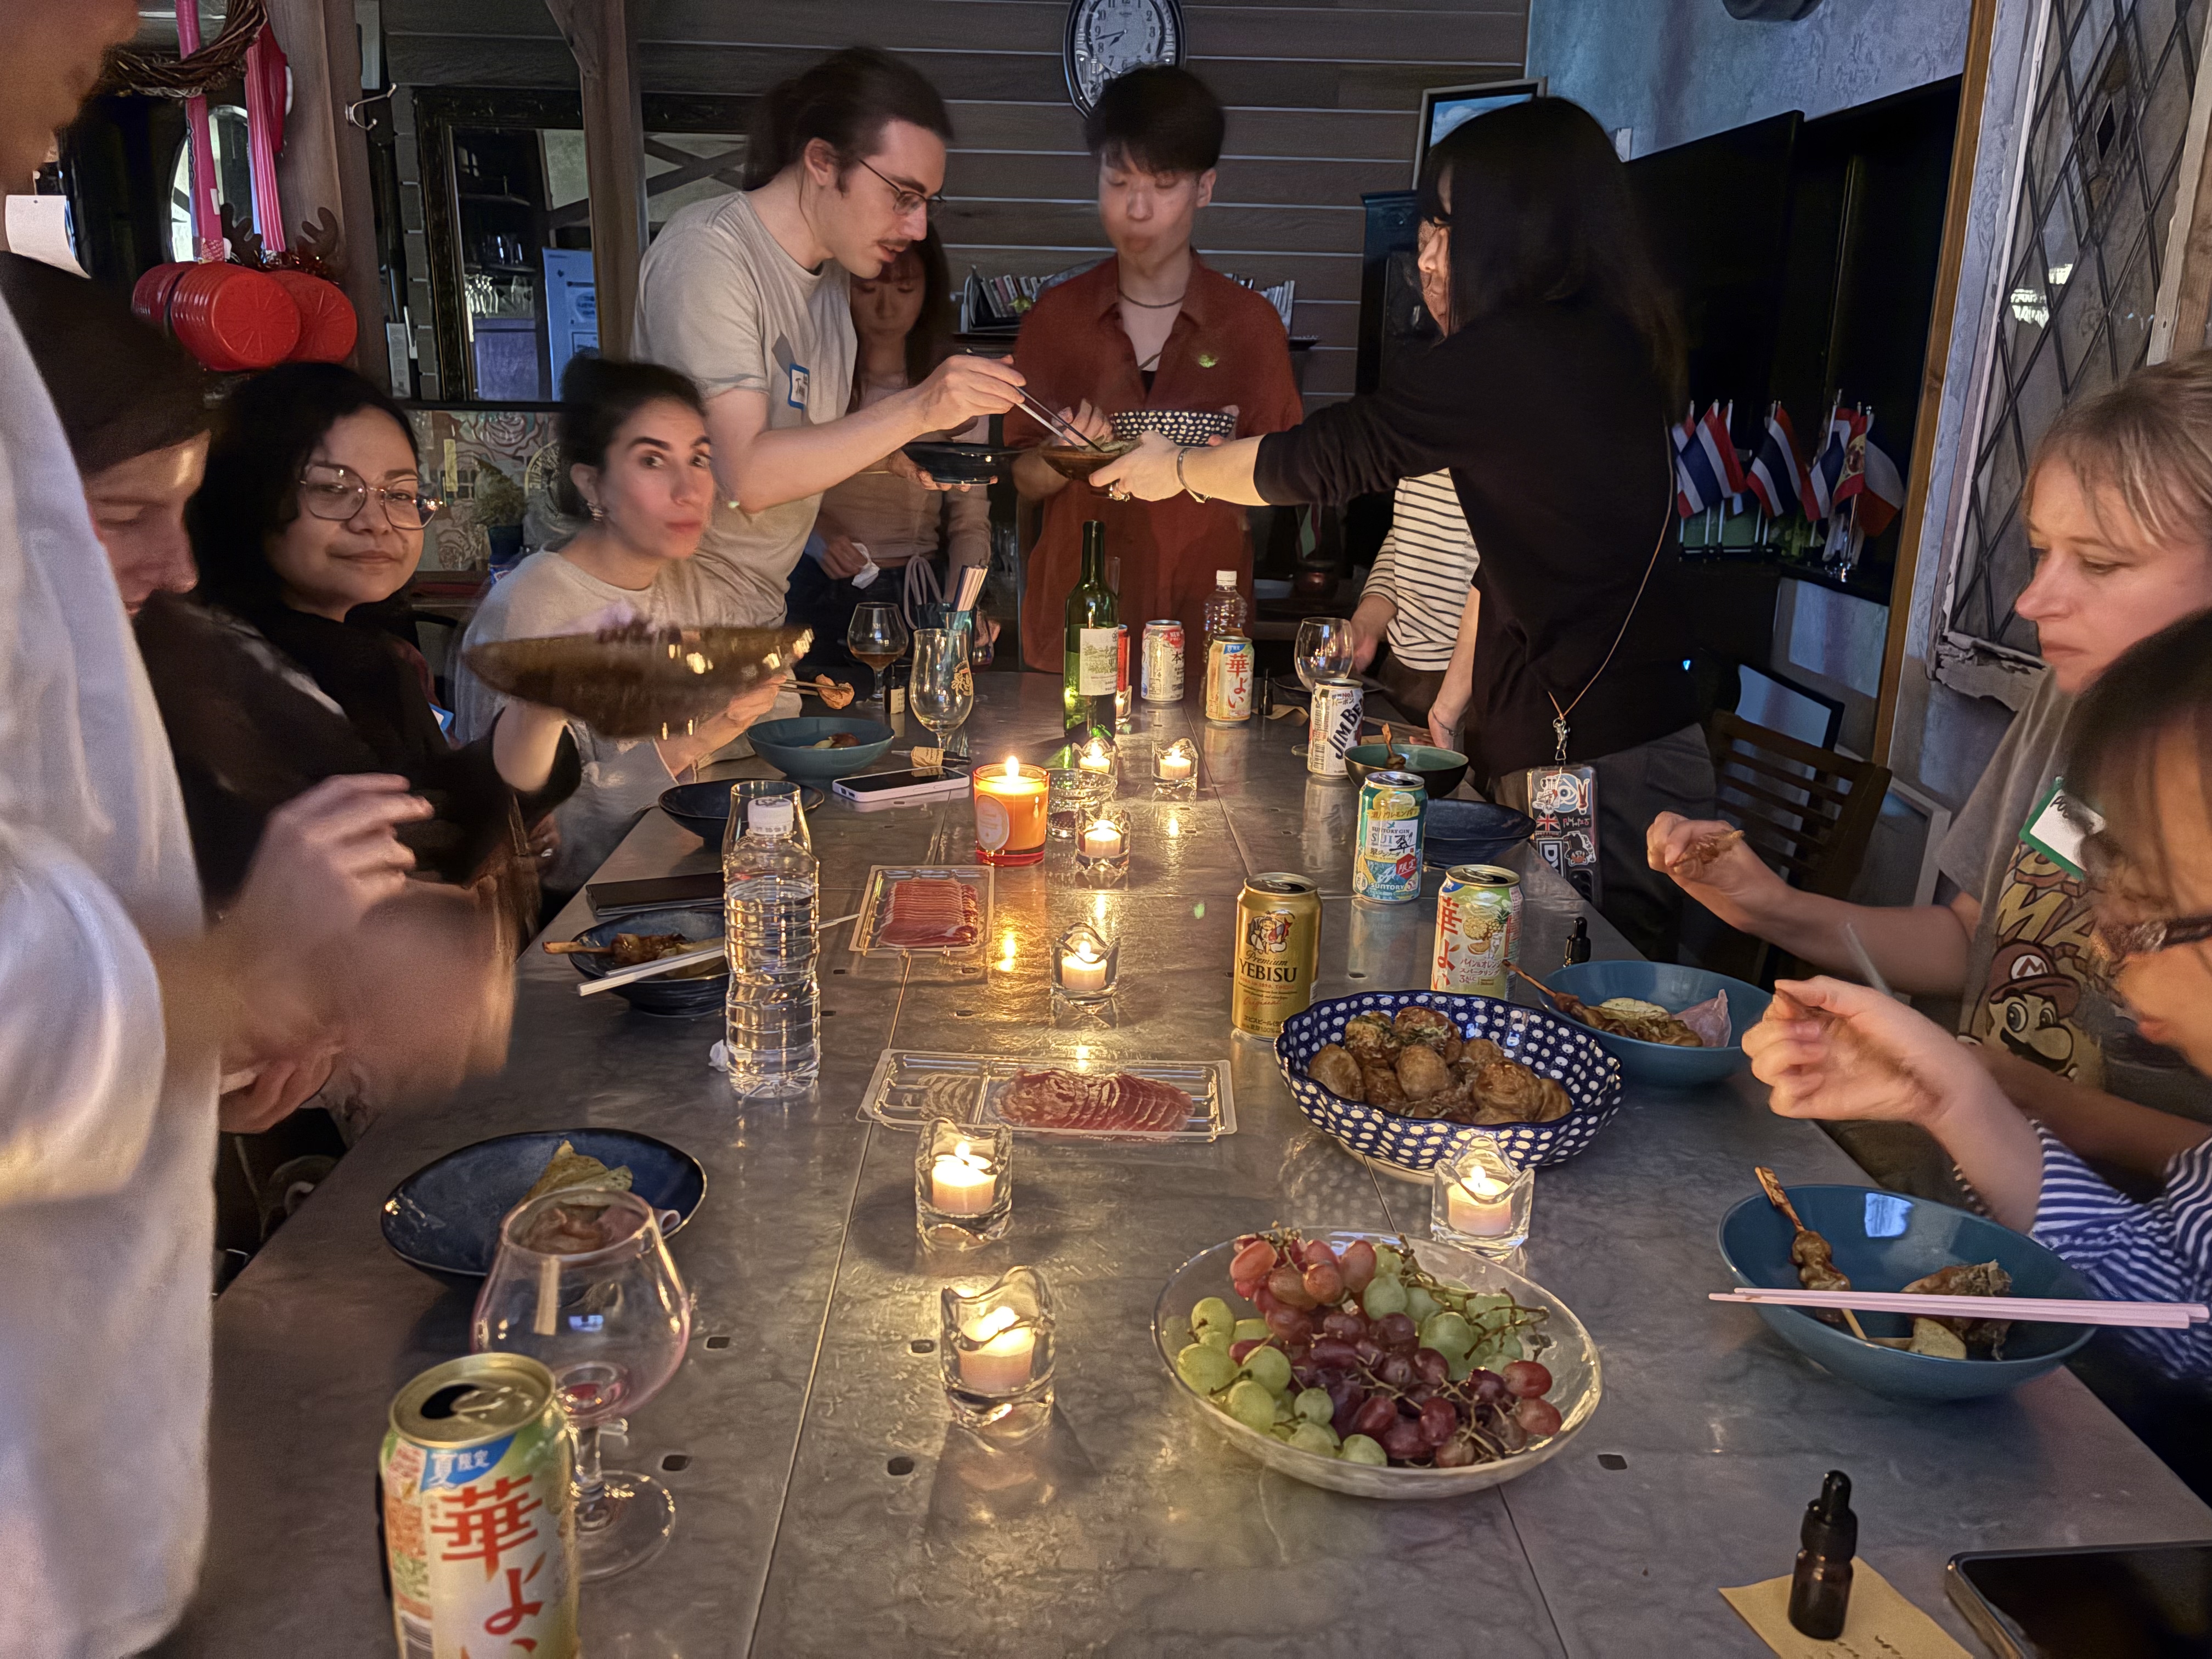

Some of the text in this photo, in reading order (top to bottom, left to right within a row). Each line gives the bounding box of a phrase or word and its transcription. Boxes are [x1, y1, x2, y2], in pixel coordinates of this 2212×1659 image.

[1097, 10, 1106, 20] 10
[1147, 10, 1152, 21] 2
[1095, 26, 1101, 36] 9
[1149, 26, 1155, 37] 3
[1098, 43, 1104, 53] 8
[1145, 43, 1151, 53] 4
[1109, 55, 1114, 66] 7
[1226, 653, 1250, 708] 華よい
[1328, 721, 1353, 760] JIM
[1371, 833, 1392, 844] SUI
[1398, 858, 1416, 874] 限定
[1244, 950, 1288, 966] Premium
[1239, 958, 1297, 983] YEBISU
[427, 1449, 490, 1489] 夏限定
